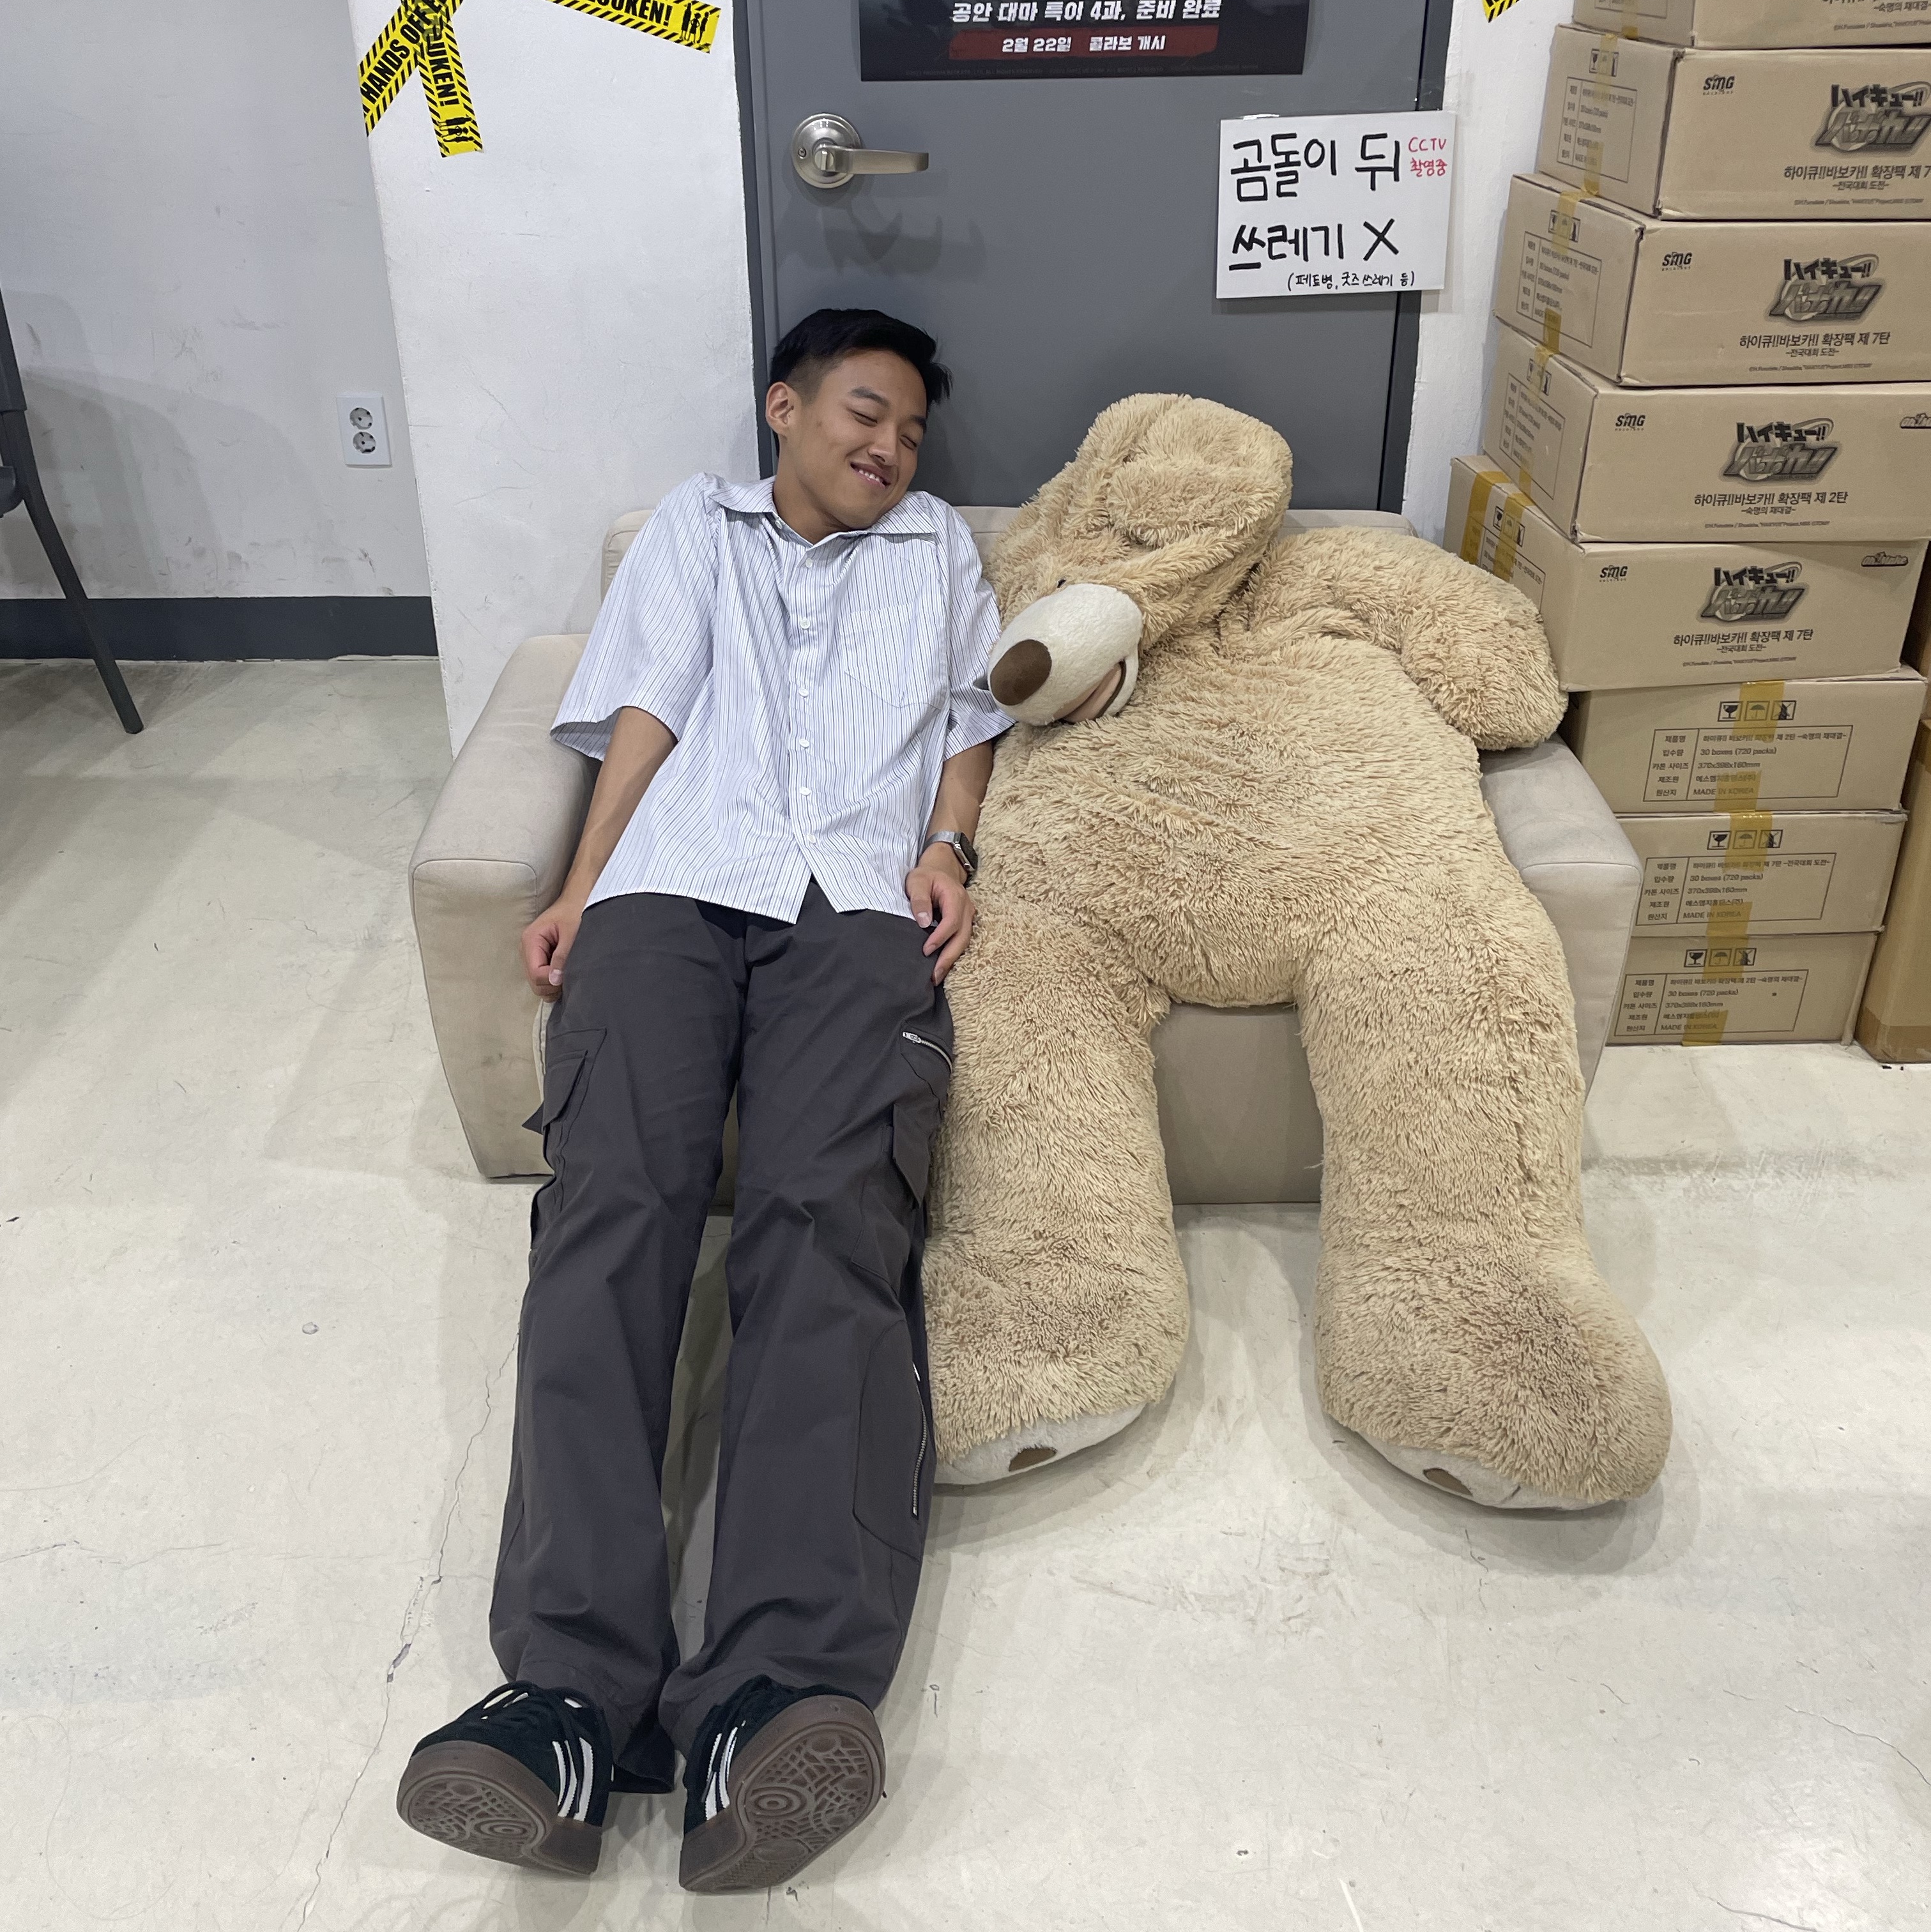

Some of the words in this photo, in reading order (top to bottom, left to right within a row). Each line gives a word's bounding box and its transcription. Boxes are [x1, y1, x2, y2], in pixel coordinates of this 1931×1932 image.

[952, 2, 993, 22] 공안
[998, 1, 1038, 22] 대마
[1044, 1, 1083, 21] 특이
[1090, 1, 1126, 20] 4과,
[1136, 0, 1175, 19] 준비
[1182, 0, 1221, 19] 완료
[1002, 37, 1028, 53] 2월
[1033, 36, 1072, 52] 22일
[1088, 36, 1132, 51] 콜라보
[1138, 35, 1166, 50] 개시
[360, 39, 410, 104] HANDS
[1408, 137, 1447, 152] CCTV
[1230, 132, 1337, 202] 곰돌이
[1355, 132, 1400, 191] 뒤
[1410, 158, 1448, 177] 촬영중
[1871, 165, 1907, 179] 확장팩
[1908, 165, 1923, 179] 제
[1229, 223, 1344, 271] 쓰레기
[1363, 218, 1399, 261] X
[1362, 273, 1393, 287] 쓰레기
[1400, 271, 1414, 286] 등)
[1822, 332, 1856, 346] 확장팩
[1857, 331, 1869, 346] 제
[1872, 331, 1891, 345] 7탄
[1778, 492, 1812, 505] 확장팩
[1813, 492, 1826, 504] 제
[1828, 491, 1849, 504] 2탄
[1750, 630, 1781, 643] 확장팩
[1783, 629, 1794, 641] 제
[1797, 628, 1813, 641] 7탄
[1735, 747, 1752, 756] (720
[1753, 747, 1776, 755] packs)
